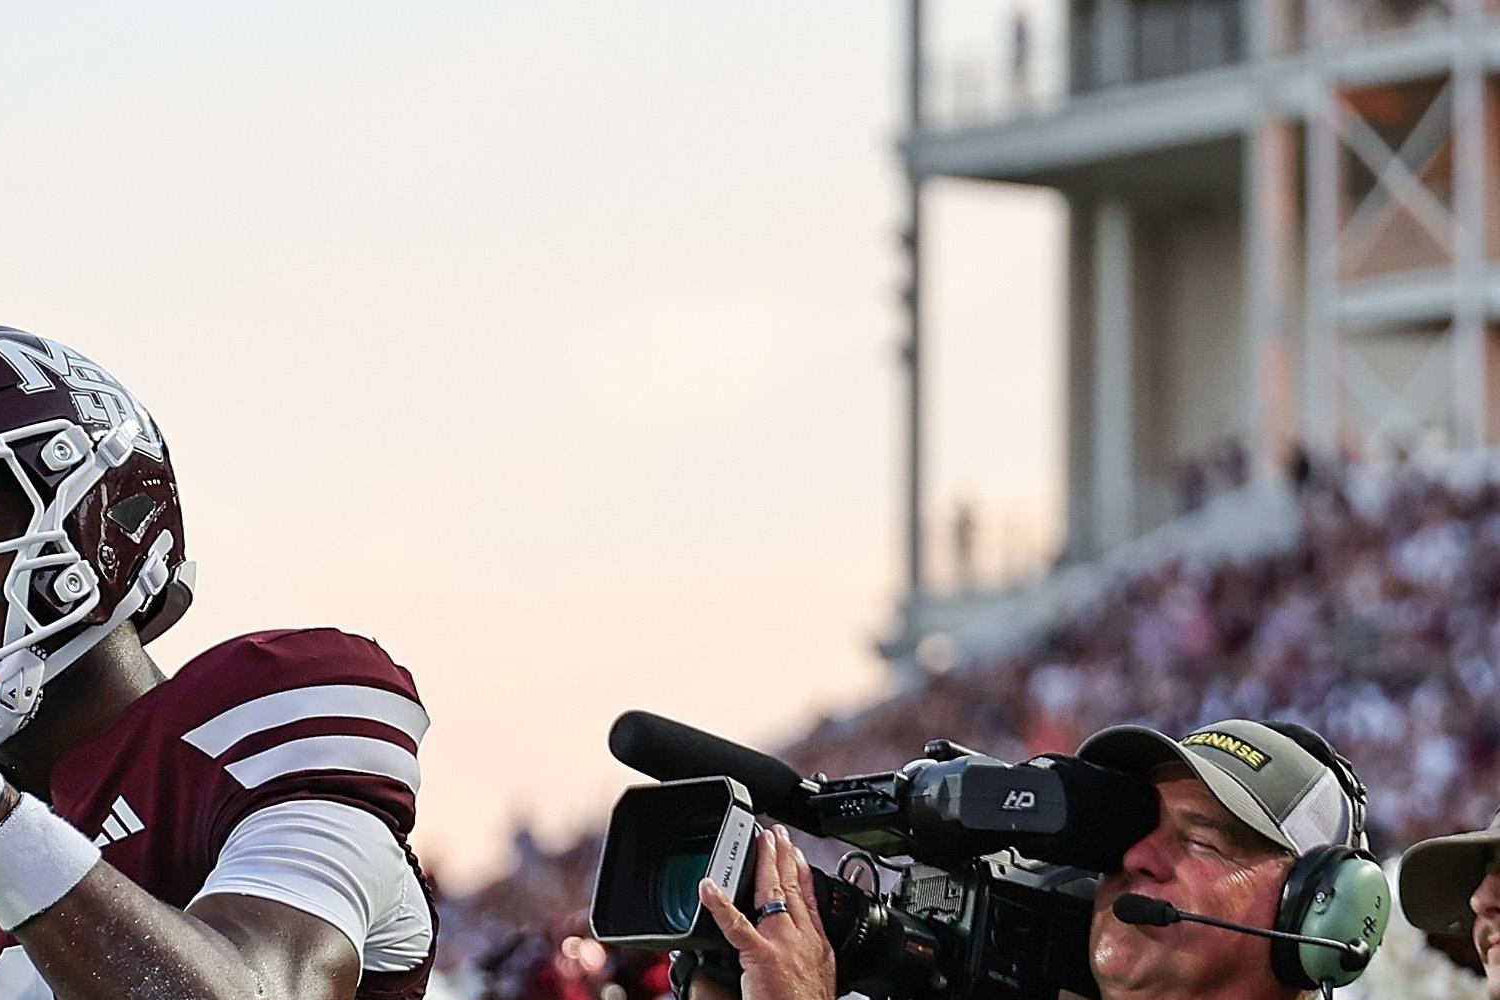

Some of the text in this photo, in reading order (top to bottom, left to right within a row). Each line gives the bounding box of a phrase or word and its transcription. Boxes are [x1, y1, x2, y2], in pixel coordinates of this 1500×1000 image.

[1002, 790, 1036, 810] HD
[722, 865, 732, 887] SMALL
[729, 841, 739, 860] LENS
